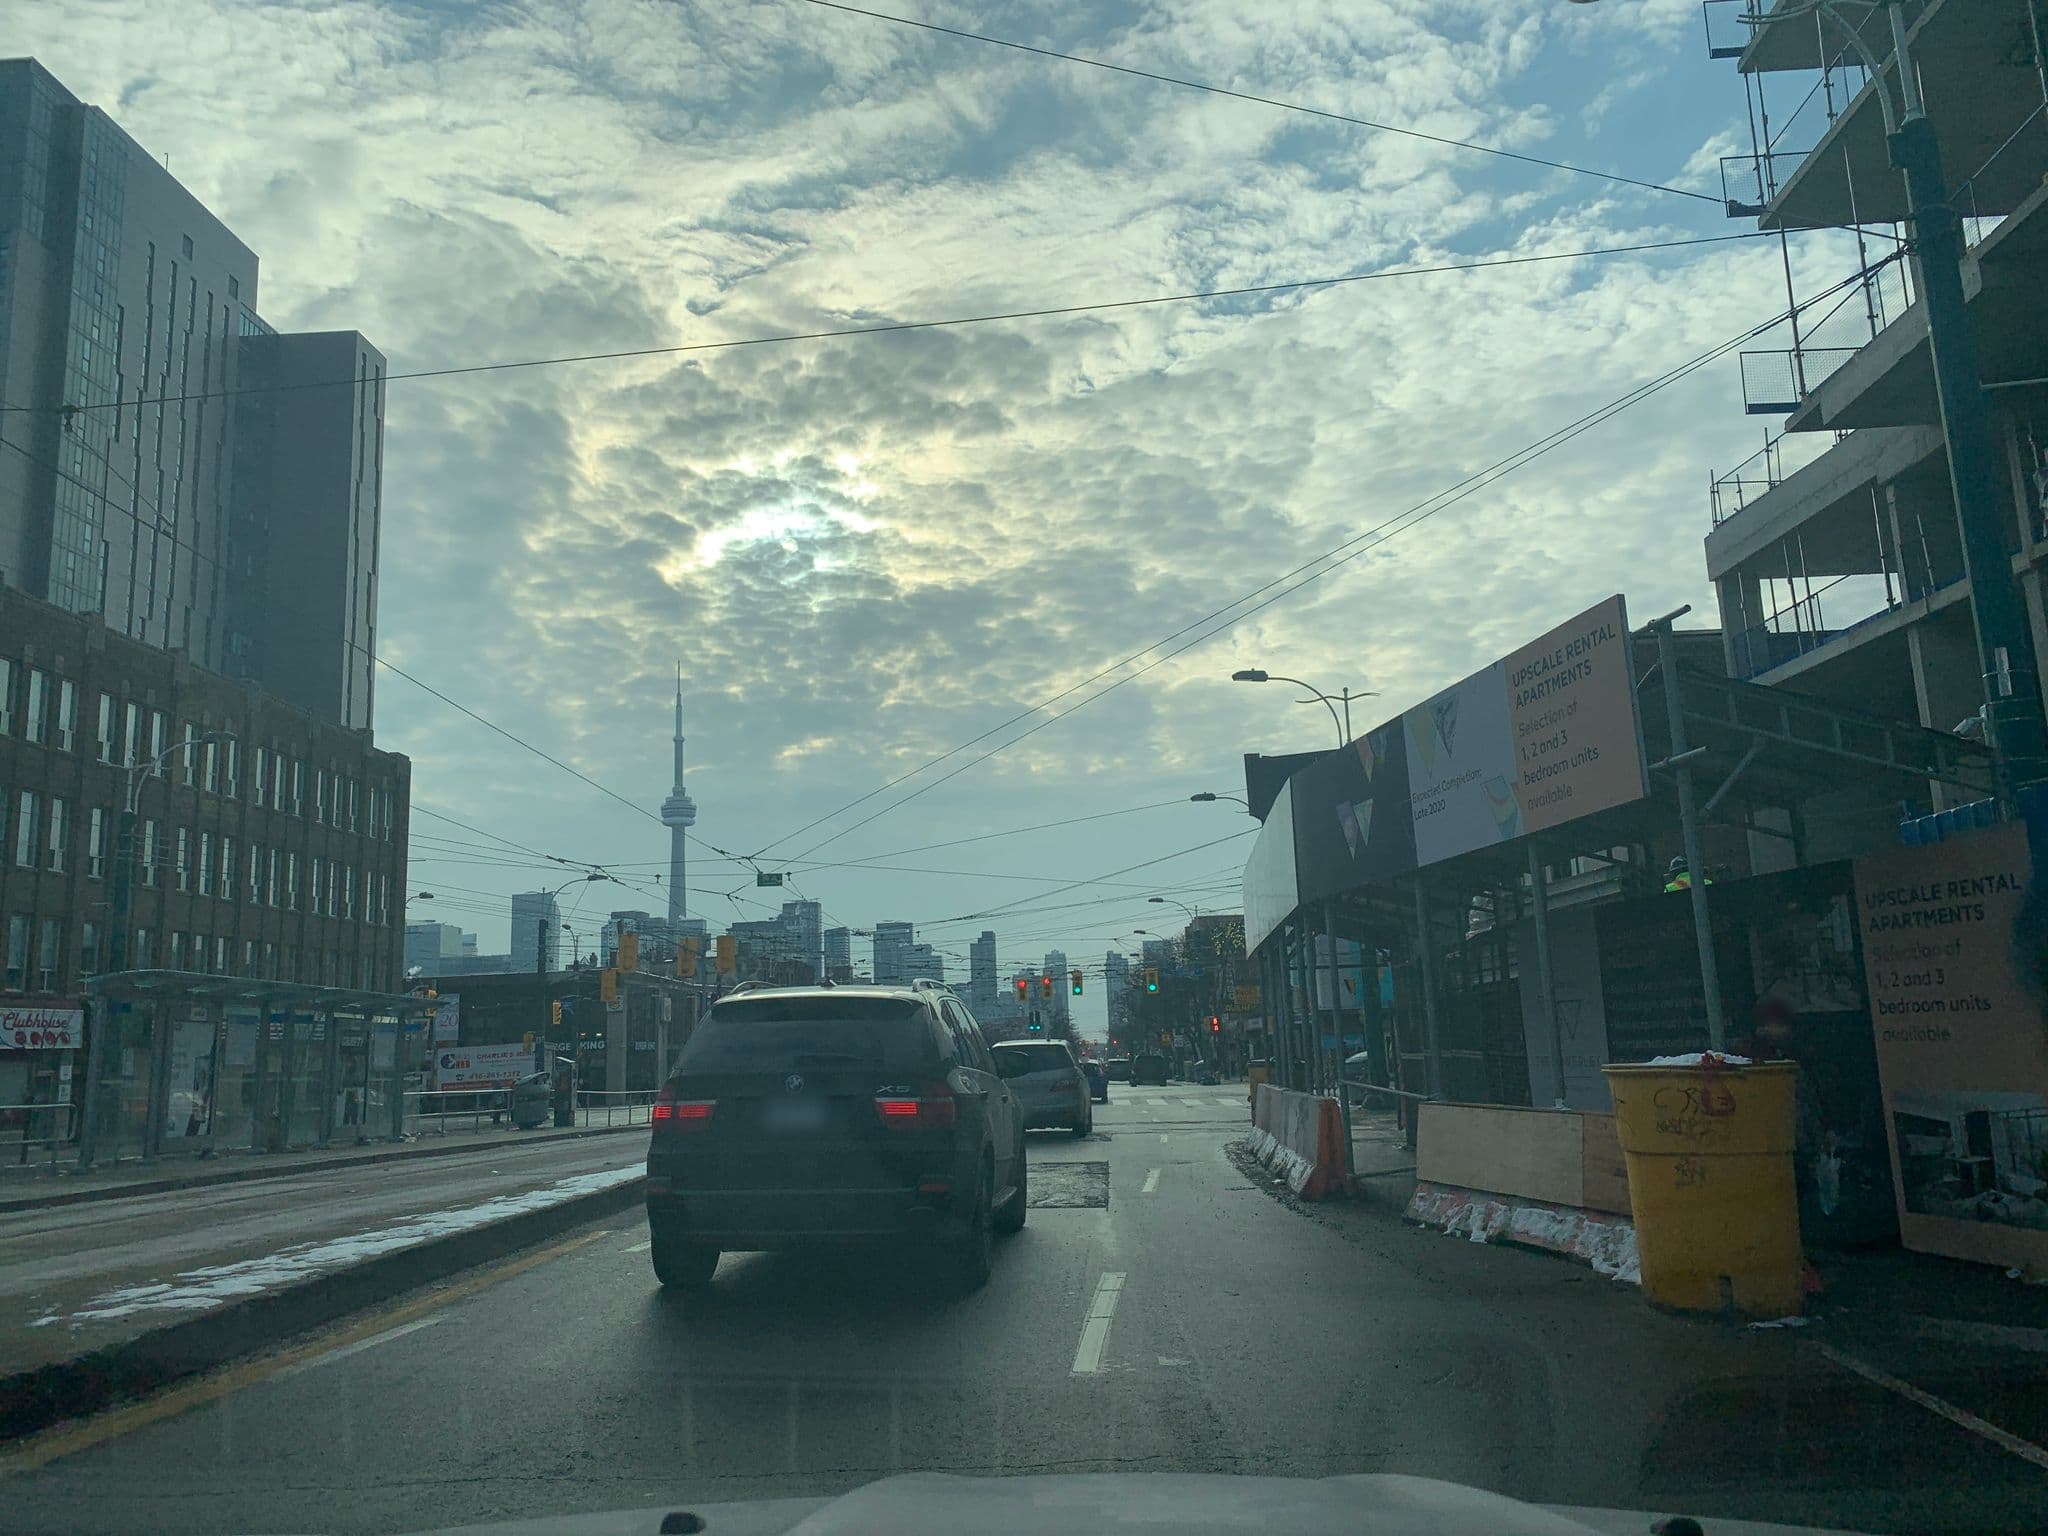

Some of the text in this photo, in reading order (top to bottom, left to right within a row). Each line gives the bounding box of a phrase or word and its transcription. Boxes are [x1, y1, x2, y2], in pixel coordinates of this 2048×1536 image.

[1512, 623, 1616, 688] UPSCALE RENTAL
[1515, 658, 1592, 710] APARTMENTS
[1518, 697, 1578, 737] Selection of
[1531, 742, 1538, 758] 2
[1540, 732, 1559, 754] and
[1560, 729, 1568, 745] 3
[1524, 746, 1600, 785] bedroom units
[1527, 784, 1573, 811] available
[1865, 872, 2022, 909] UPSCALE RENTAL
[1870, 903, 1985, 933] APARTMENTS
[1890, 971, 1900, 987] 2
[1903, 970, 1932, 987] and
[1935, 968, 1945, 985] 3
[1878, 994, 1992, 1014] bedroom units
[3, 1011, 69, 1030] Clubhouse
[1882, 1024, 1951, 1041] available
[580, 1040, 605, 1050] KING
[876, 1085, 910, 1093] X5
